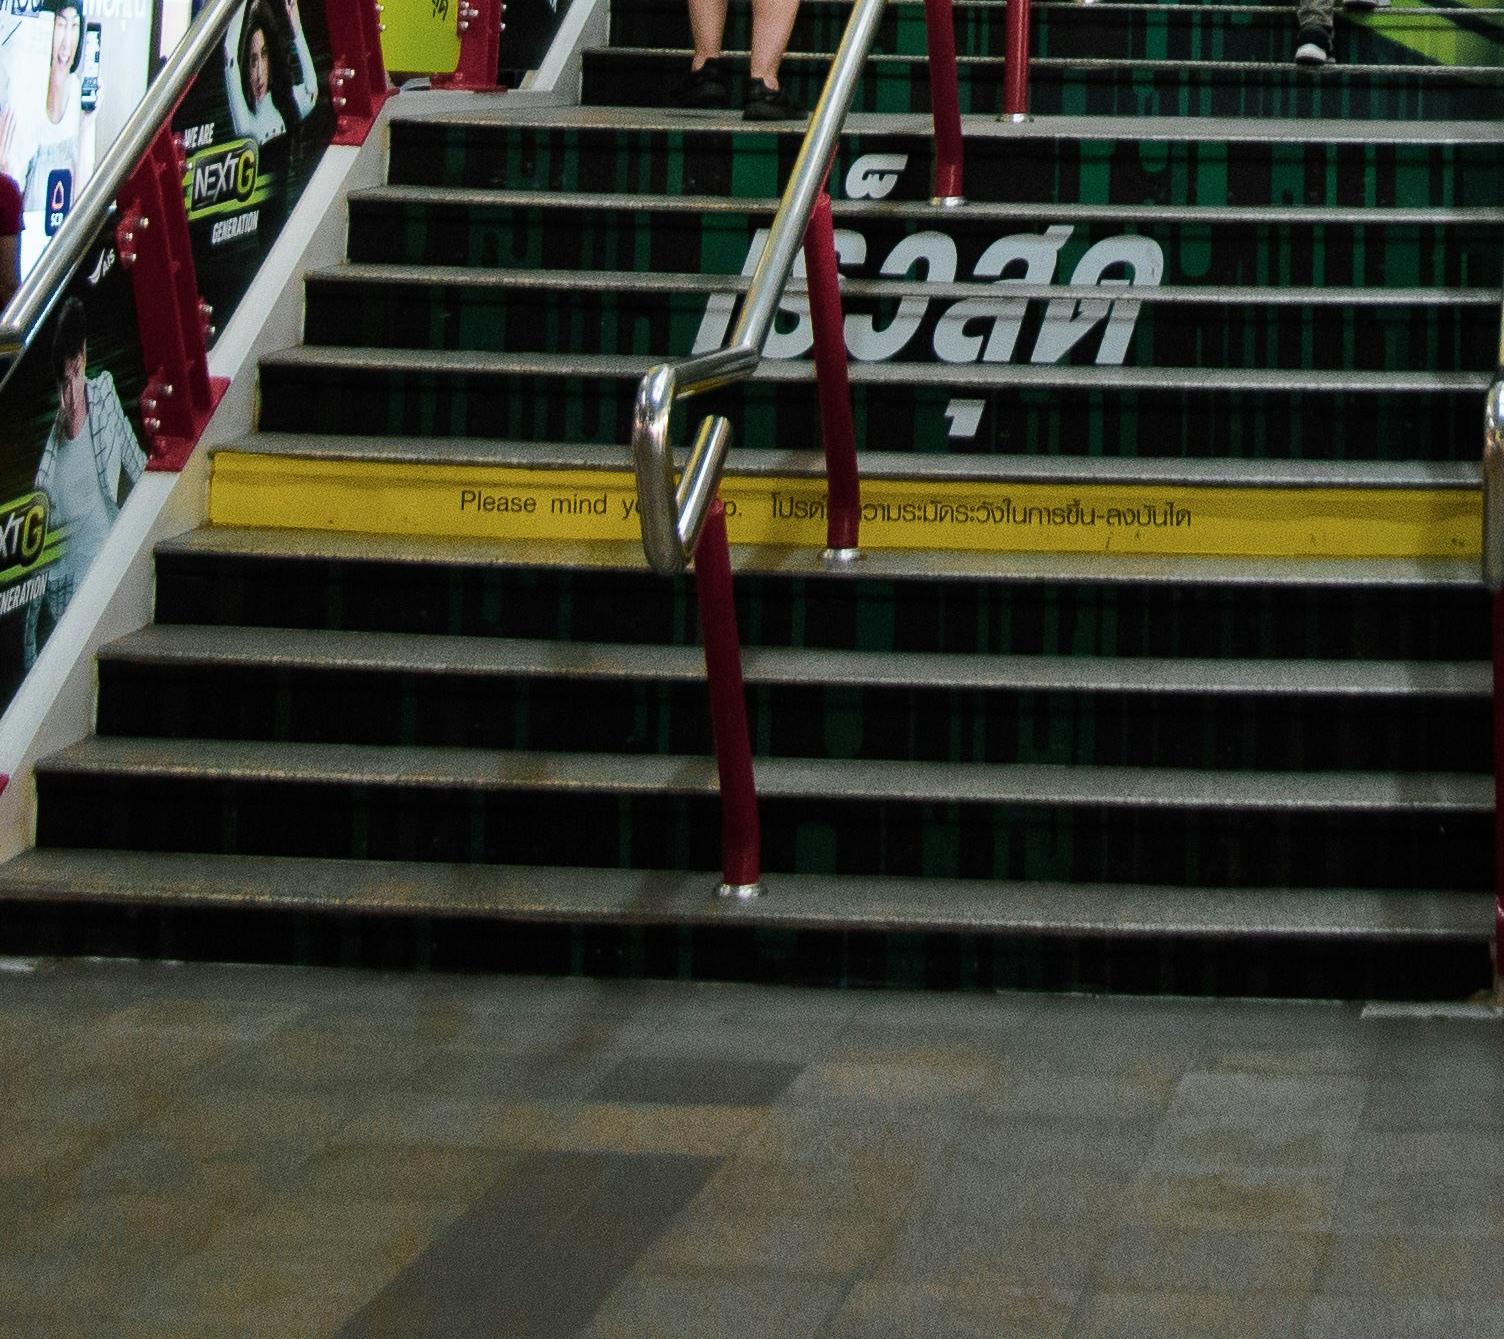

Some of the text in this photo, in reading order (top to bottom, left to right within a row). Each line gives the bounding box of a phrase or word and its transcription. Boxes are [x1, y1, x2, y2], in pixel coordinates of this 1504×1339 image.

[185, 122, 215, 150] WE ARE
[211, 209, 260, 245] GENERATION
[460, 489, 537, 514] Please
[551, 493, 607, 516] mind
